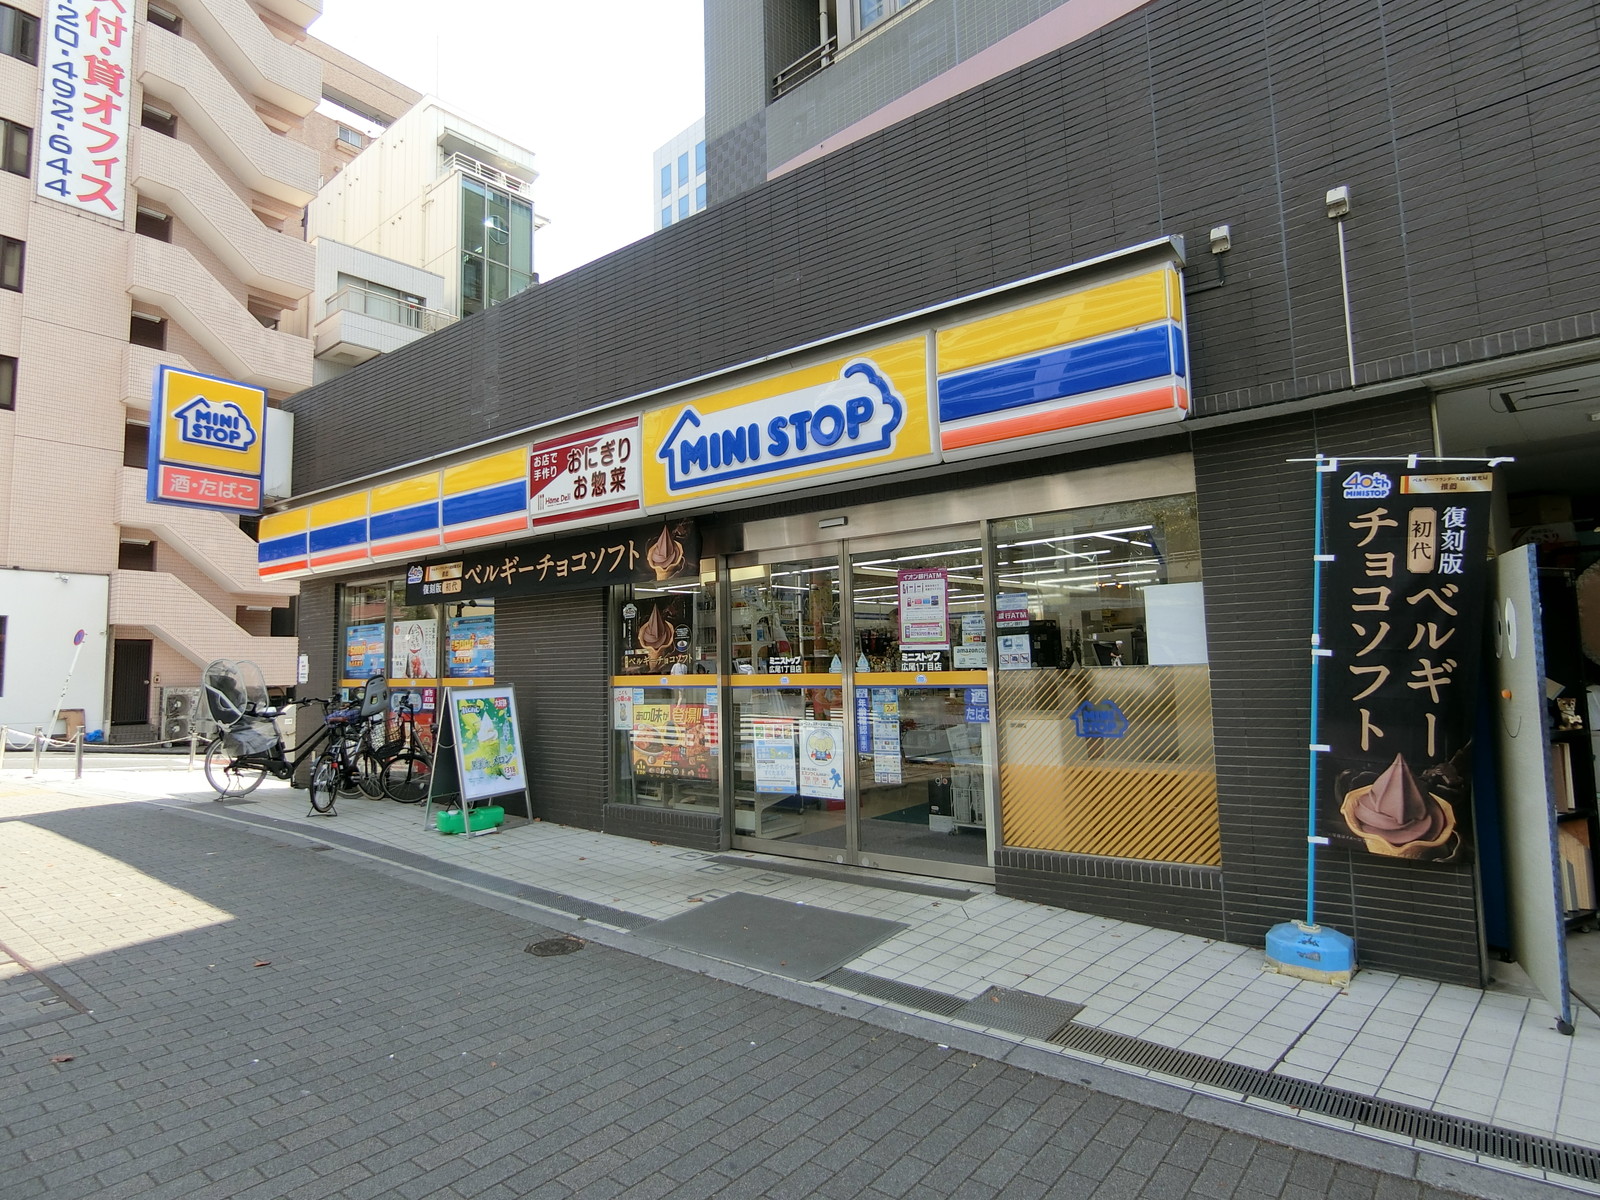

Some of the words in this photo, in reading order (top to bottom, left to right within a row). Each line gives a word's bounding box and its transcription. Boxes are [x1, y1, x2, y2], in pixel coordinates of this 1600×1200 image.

[195, 409, 239, 430] MINI
[191, 423, 241, 444] STOP
[680, 422, 760, 475] MINI
[767, 395, 875, 457] STOP
[533, 452, 558, 468] お店で
[567, 437, 631, 474] おにぎり
[533, 466, 557, 482] 手作り
[1344, 473, 1390, 489] 40th
[170, 473, 254, 501] 酒・たばこ
[573, 465, 626, 501] お惣菜
[545, 496, 560, 505] Home
[560, 492, 571, 502] Deli
[1345, 489, 1387, 497] MINISTOP
[1411, 520, 1432, 560] 初代
[1437, 505, 1467, 576] 復刻版
[464, 538, 640, 586] ベルギーチョコソフト
[903, 573, 942, 581] イオン銀行ATM
[998, 611, 1027, 620] 銀行ATM
[1348, 506, 1400, 751] チョコソフト
[769, 655, 801, 665] ミニストップ
[901, 651, 941, 662] ミニストップ
[768, 664, 802, 674] 広尾1丁目店
[901, 661, 942, 672] 広尾1丁目店
[1405, 583, 1460, 758] ベルギー
[970, 688, 988, 706] 酒
[635, 707, 669, 723] あの味が
